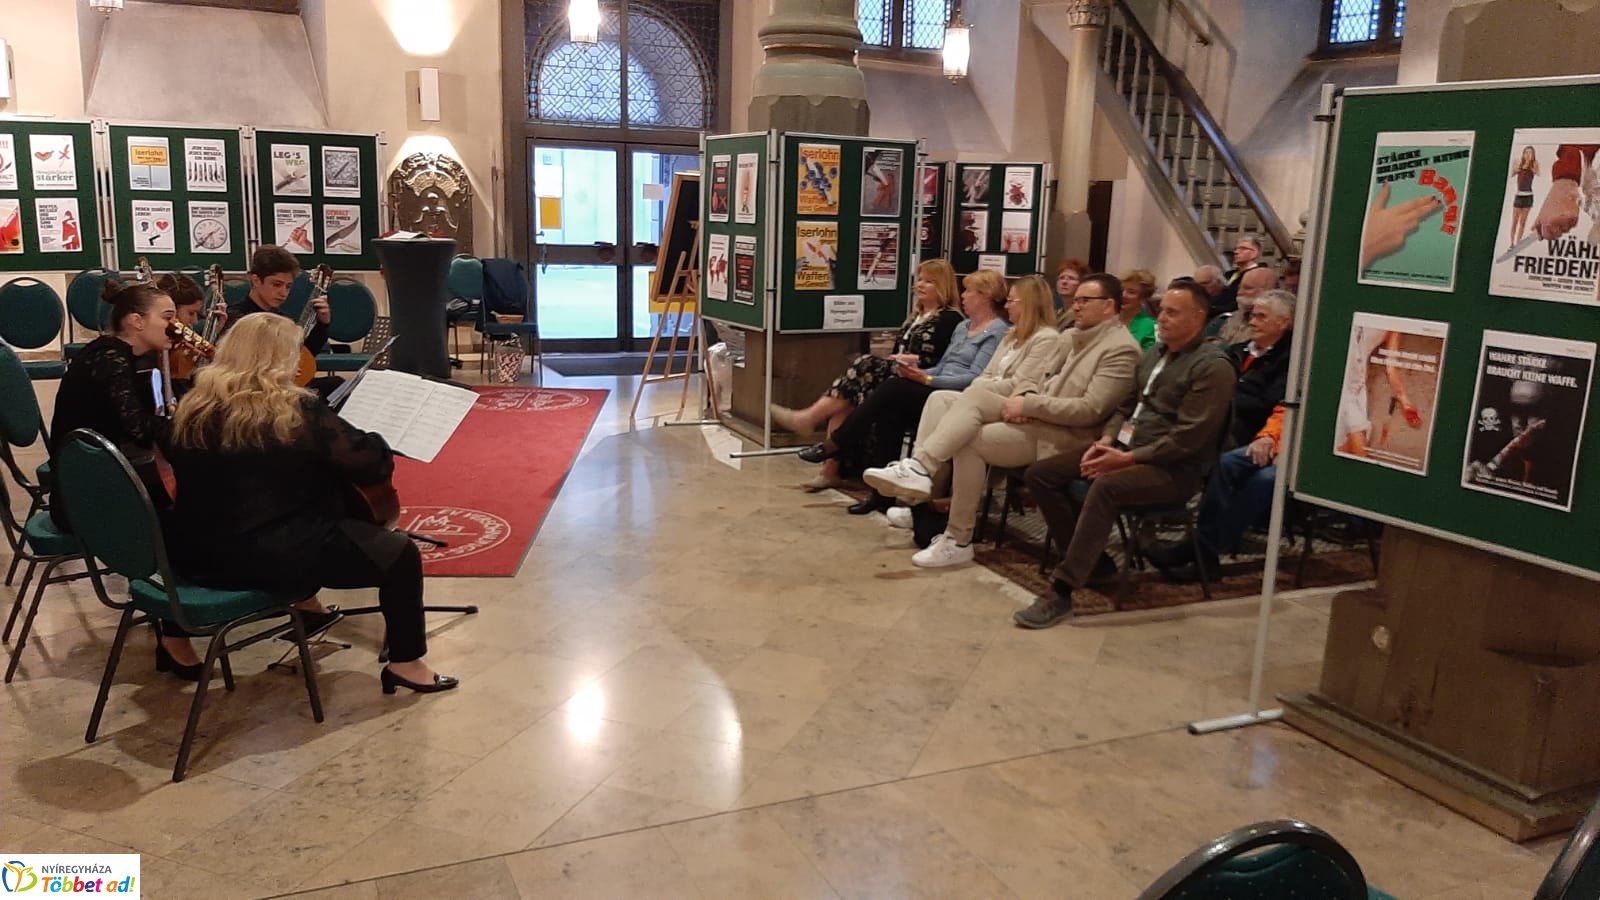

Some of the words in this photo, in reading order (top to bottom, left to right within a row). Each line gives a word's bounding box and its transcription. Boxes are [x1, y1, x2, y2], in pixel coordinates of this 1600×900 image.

[797, 225, 837, 238] Iserlohn
[797, 271, 830, 281] Waffen
[1514, 256, 1600, 280] FRIEDEN!
[1489, 351, 1516, 365] WAHRE
[1517, 352, 1548, 369] STÄRKE
[1486, 365, 1522, 380] BRAUCHT
[1522, 369, 1547, 384] KEINE
[1548, 375, 1579, 389] WAFFE.
